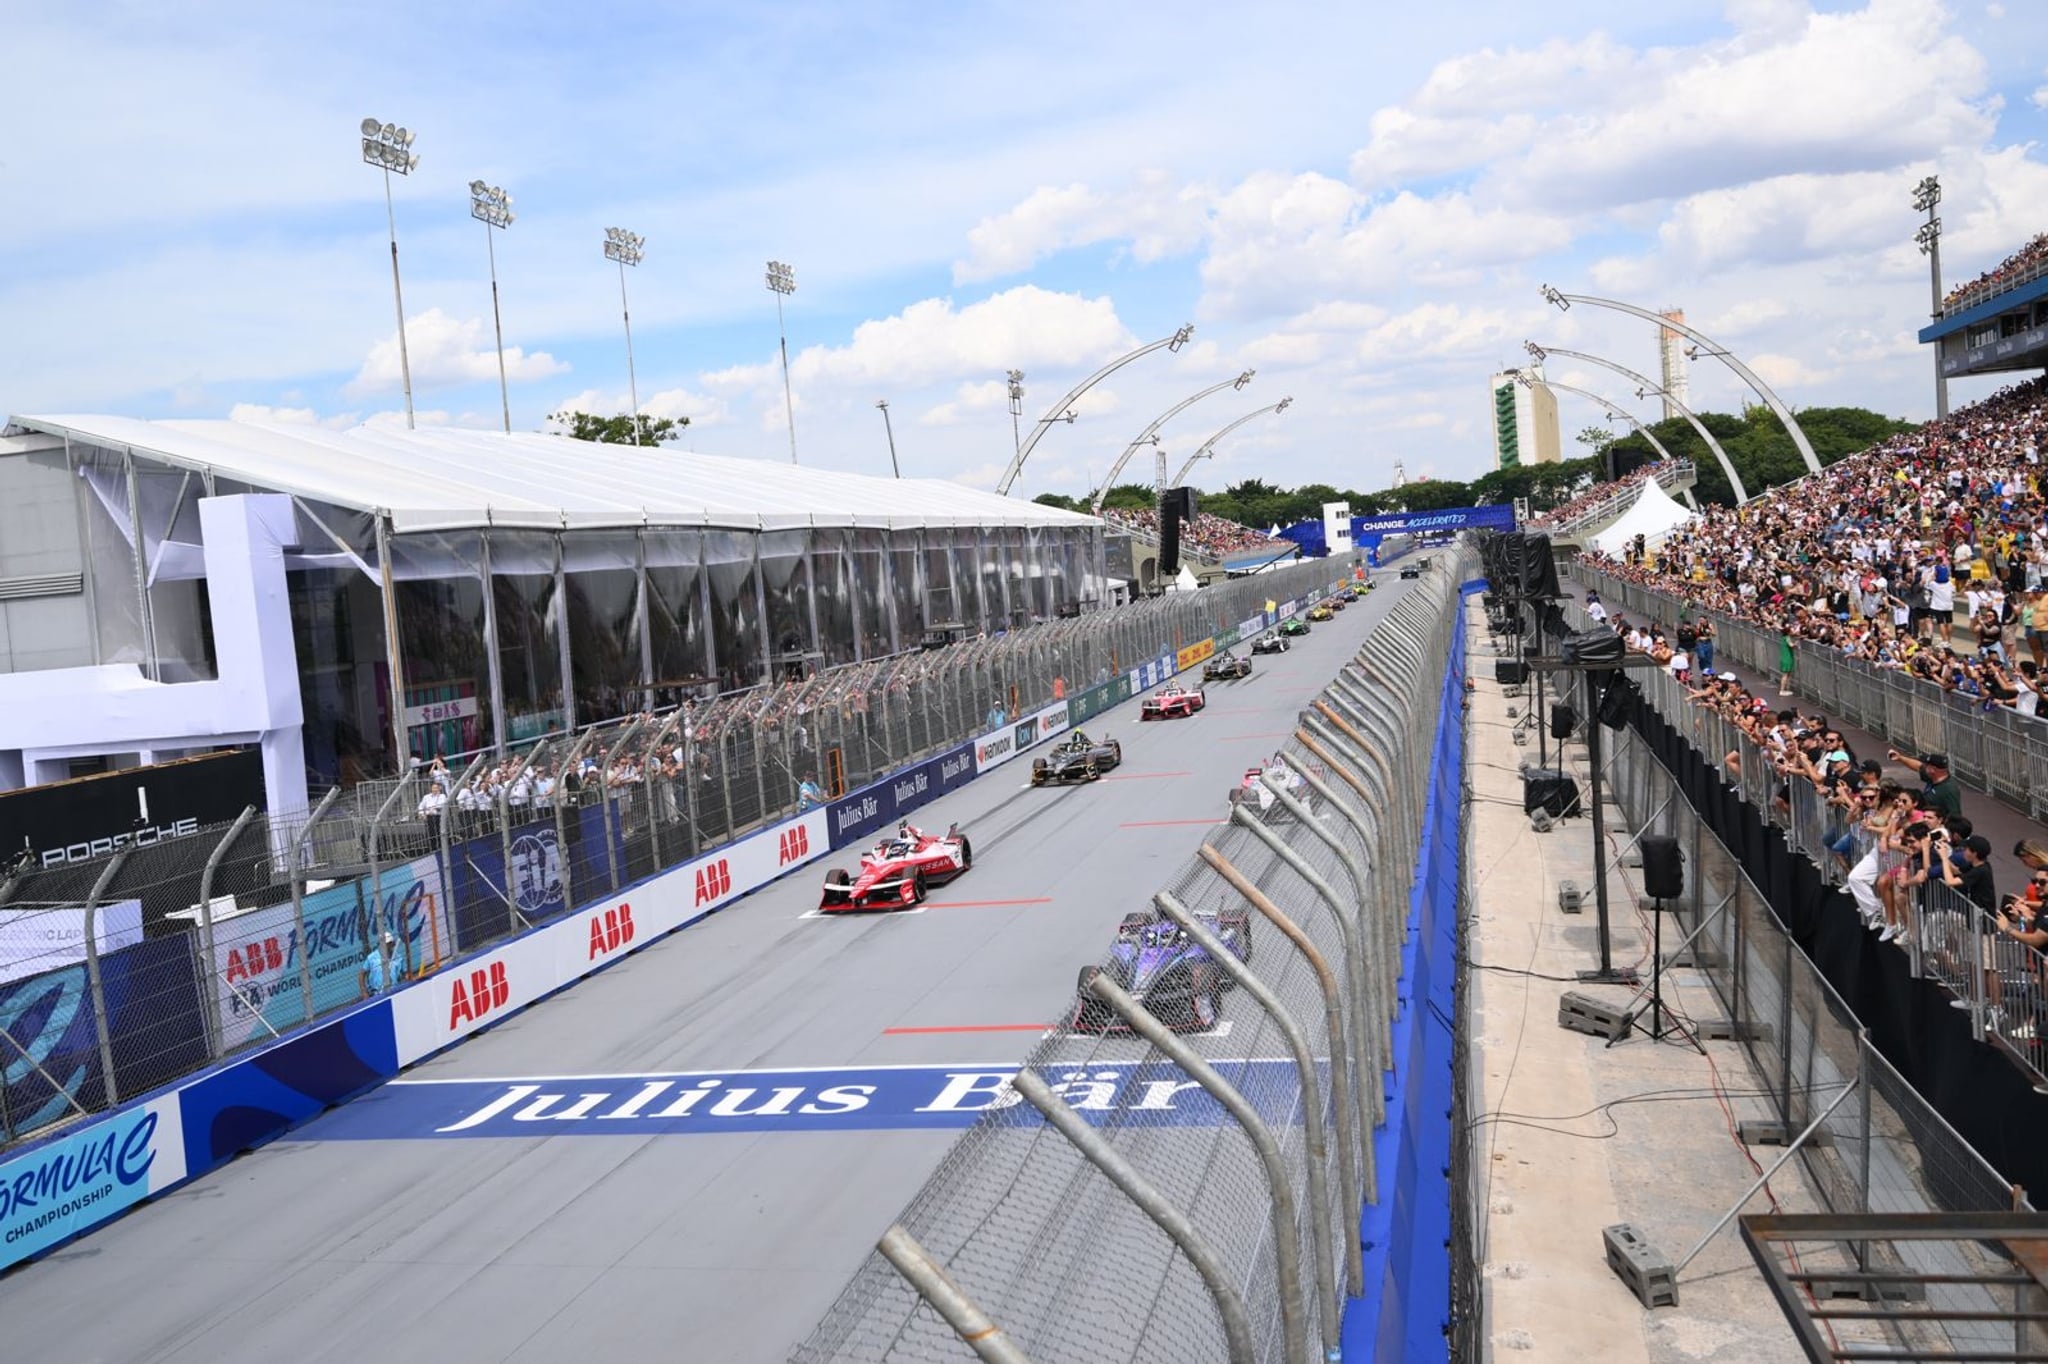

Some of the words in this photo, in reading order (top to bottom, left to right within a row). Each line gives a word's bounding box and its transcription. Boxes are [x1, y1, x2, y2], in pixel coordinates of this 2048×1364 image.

[894, 781, 915, 808] Julius
[915, 773, 928, 793] Bär
[941, 760, 960, 785] Julius
[959, 753, 970, 772] Bär
[837, 805, 863, 835] Julius
[862, 797, 878, 819] Bär
[42, 817, 198, 869] PORSCHE
[779, 824, 808, 866] ABB
[695, 858, 731, 907] ABB
[589, 903, 635, 960] ABB
[226, 936, 283, 984] ABB
[267, 973, 312, 997] WORL
[450, 960, 510, 1031] ABB
[434, 1079, 877, 1133] Julius
[914, 1072, 1203, 1113] Bär
[0, 1131, 116, 1221] ORMULA
[5, 1183, 113, 1243] CHAMPIONSHIP
